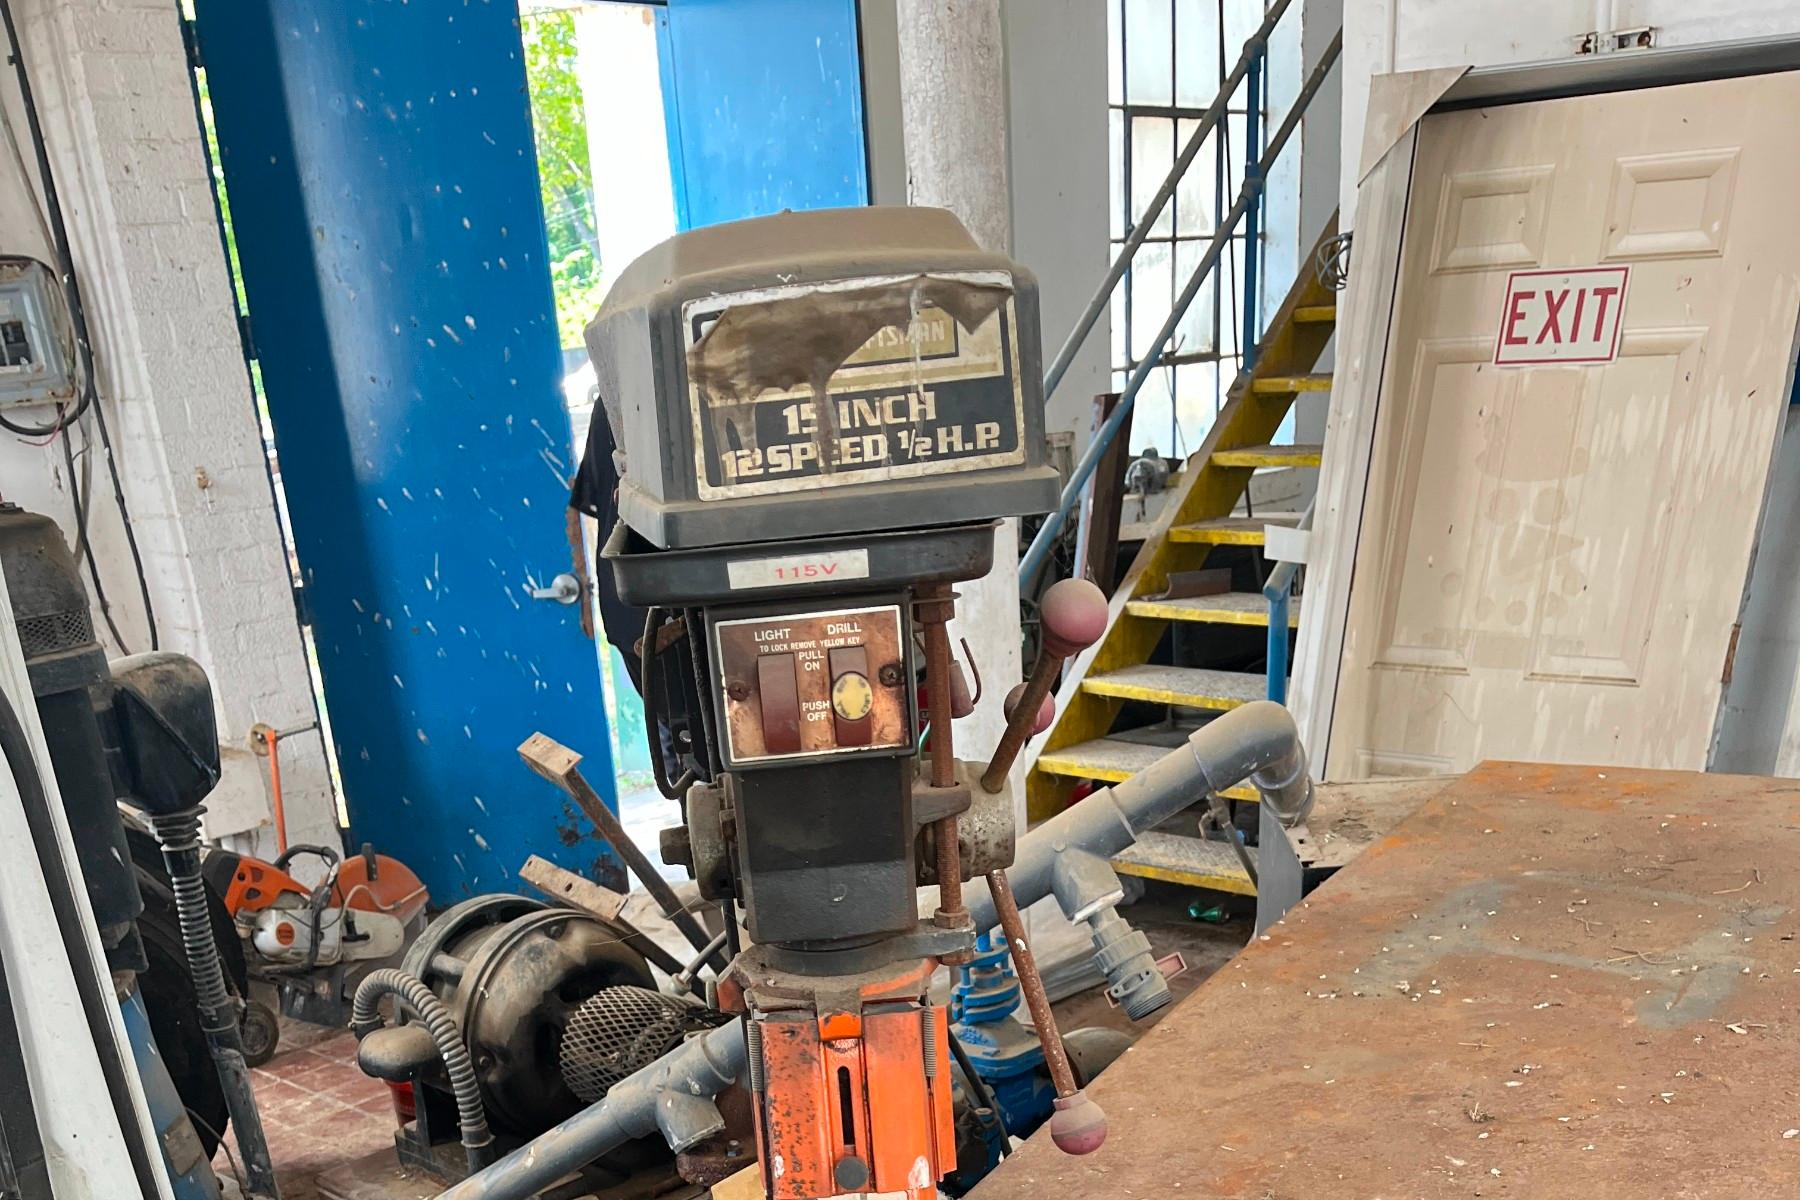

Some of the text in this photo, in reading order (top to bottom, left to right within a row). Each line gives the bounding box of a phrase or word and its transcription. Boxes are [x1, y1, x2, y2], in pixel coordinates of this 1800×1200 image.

[1504, 287, 1619, 345] EXIT
[782, 391, 938, 436] 15 INCH
[721, 447, 763, 478] 12
[766, 434, 888, 473] SPEED
[937, 421, 1001, 454] H.P.
[775, 563, 838, 579] 115V
[754, 628, 791, 642] LIGHT
[827, 622, 862, 635] DRILL
[760, 636, 861, 652] TO LOCK REMOVE YELLOW KEY
[798, 649, 825, 660] PULL
[804, 661, 820, 671] ON
[802, 700, 830, 711] PUSH
[807, 711, 828, 722] OFF
